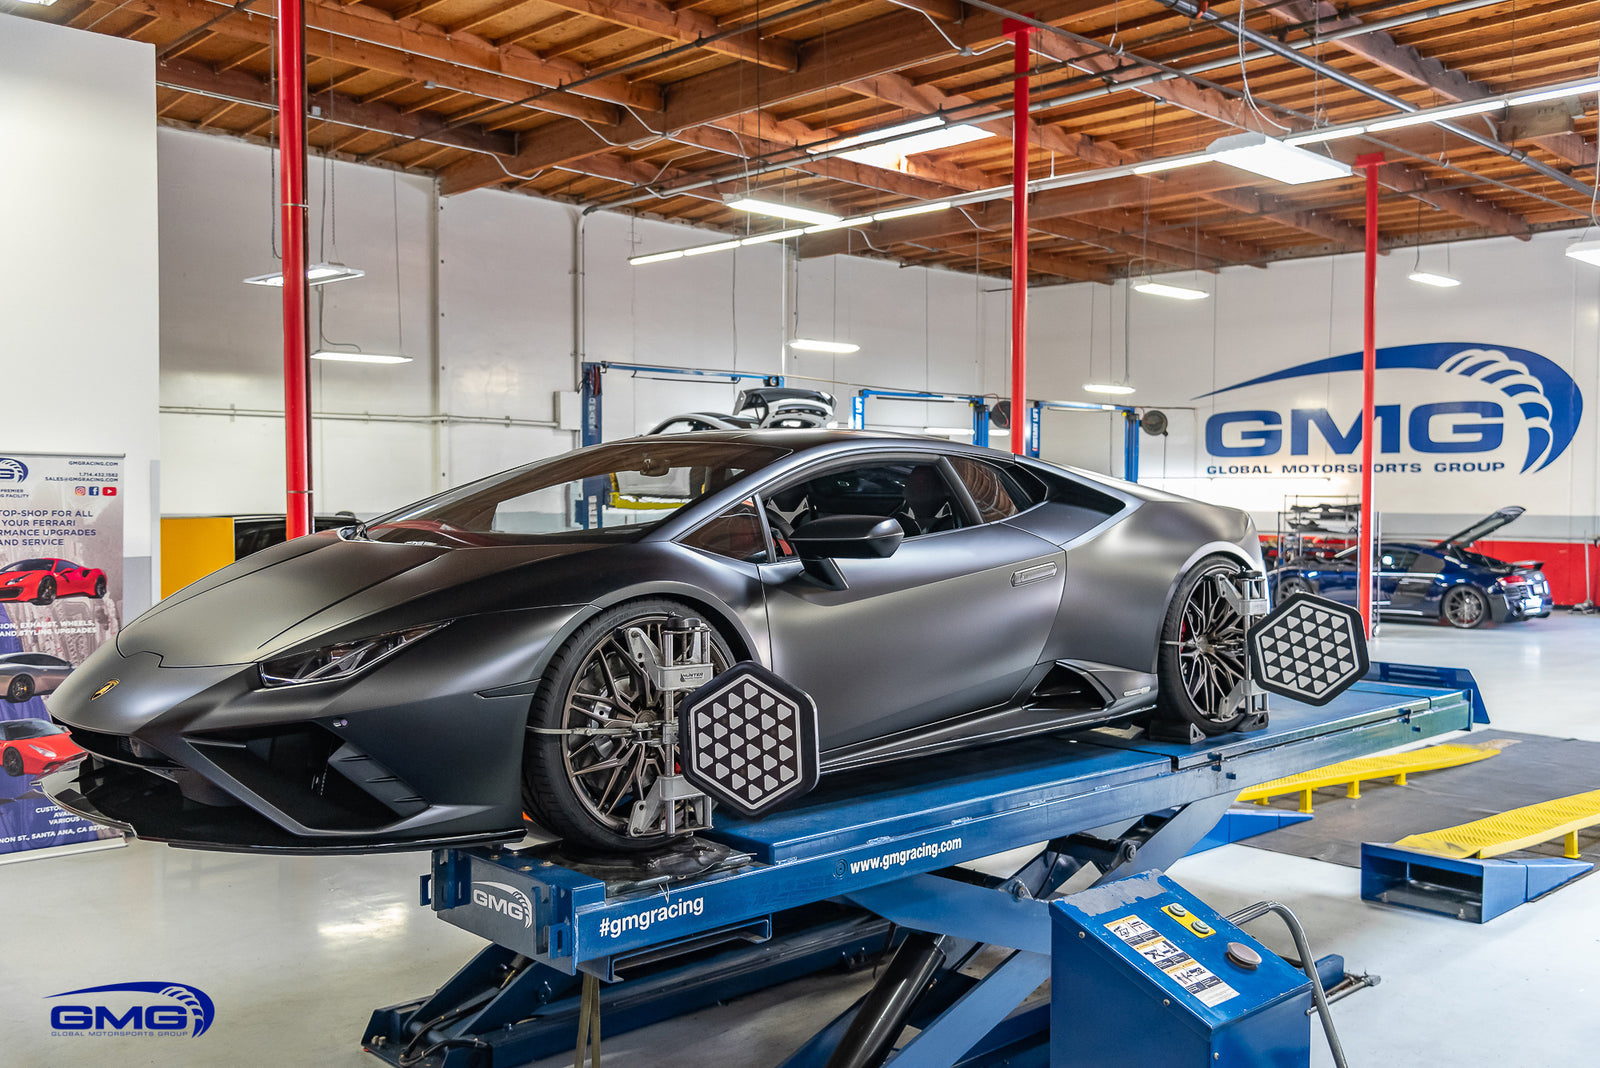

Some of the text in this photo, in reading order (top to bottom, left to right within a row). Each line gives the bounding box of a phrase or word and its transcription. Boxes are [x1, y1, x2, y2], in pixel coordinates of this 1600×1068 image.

[1205, 401, 1504, 457] GMG
[1207, 465, 1273, 474] GLOBAL
[1433, 462, 1505, 473] GROUP
[51, 509, 72, 517] FOR
[22, 538, 64, 546] SERVICE
[20, 620, 58, 629] EXHAUST,
[60, 619, 95, 627] WHEELS,
[18, 628, 52, 636] STYLING
[35, 805, 62, 813] CUSTO
[48, 816, 80, 825] VARIOUS
[31, 831, 56, 840] SANTA
[850, 837, 962, 874] www.gmgracing.com
[473, 888, 524, 921] GMG
[599, 896, 704, 938] #gmgracing
